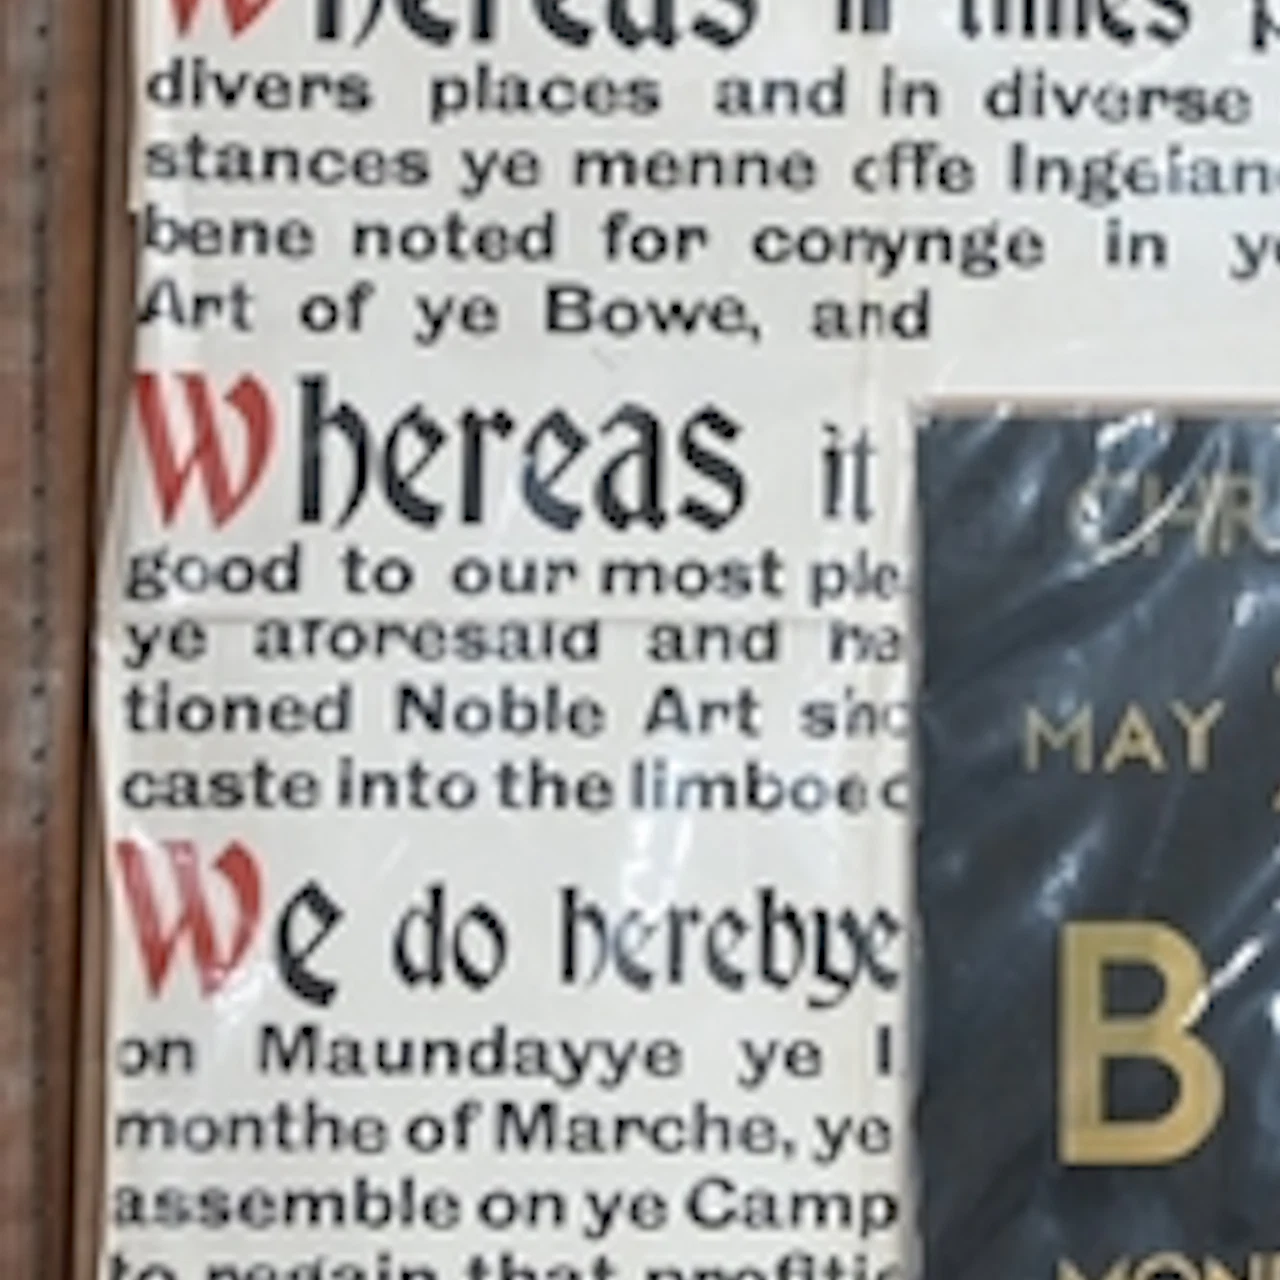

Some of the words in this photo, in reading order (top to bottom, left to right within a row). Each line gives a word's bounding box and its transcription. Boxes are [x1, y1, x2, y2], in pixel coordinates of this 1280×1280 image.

[145, 56, 373, 112] divers
[429, 59, 662, 123] places
[714, 66, 847, 115] and
[881, 65, 941, 117] in
[984, 66, 1253, 123] diverse
[144, 133, 431, 187] stances
[461, 148, 542, 198] ye
[573, 147, 818, 190] menne
[140, 206, 316, 257] bene
[353, 211, 557, 262] noted
[603, 211, 708, 263] for
[1106, 219, 1168, 267] in
[139, 278, 255, 333] Art
[301, 280, 376, 335] of
[414, 293, 499, 347] ye
[545, 286, 761, 343] Bowe,
[812, 288, 931, 340] and
[134, 371, 747, 531] Whereas
[822, 422, 878, 525] it
[124, 543, 302, 602] good
[341, 551, 416, 597] to
[451, 556, 577, 597] our
[602, 551, 785, 600] most
[123, 618, 207, 669] ye
[646, 618, 781, 664] and
[122, 682, 352, 736] tioned
[397, 685, 605, 737] Noble
[643, 687, 762, 737] Art
[1025, 697, 1225, 774] MAY
[120, 758, 320, 812] caste
[338, 758, 478, 812] into
[499, 760, 614, 811] the
[632, 760, 869, 814] limboe
[117, 840, 346, 1008] We
[392, 882, 507, 992] do
[558, 883, 901, 1010] herebye
[118, 1036, 195, 1078] on
[258, 1025, 685, 1088] Maundayye
[738, 1034, 823, 1089] ye
[114, 1100, 389, 1154] monthe
[404, 1100, 482, 1154] of
[495, 1099, 796, 1161] Marche,
[813, 1114, 893, 1164] ye
[112, 1179, 462, 1230] assemble
[477, 1186, 566, 1228] on
[583, 1187, 669, 1240] ye
[683, 1178, 899, 1239] Camp
